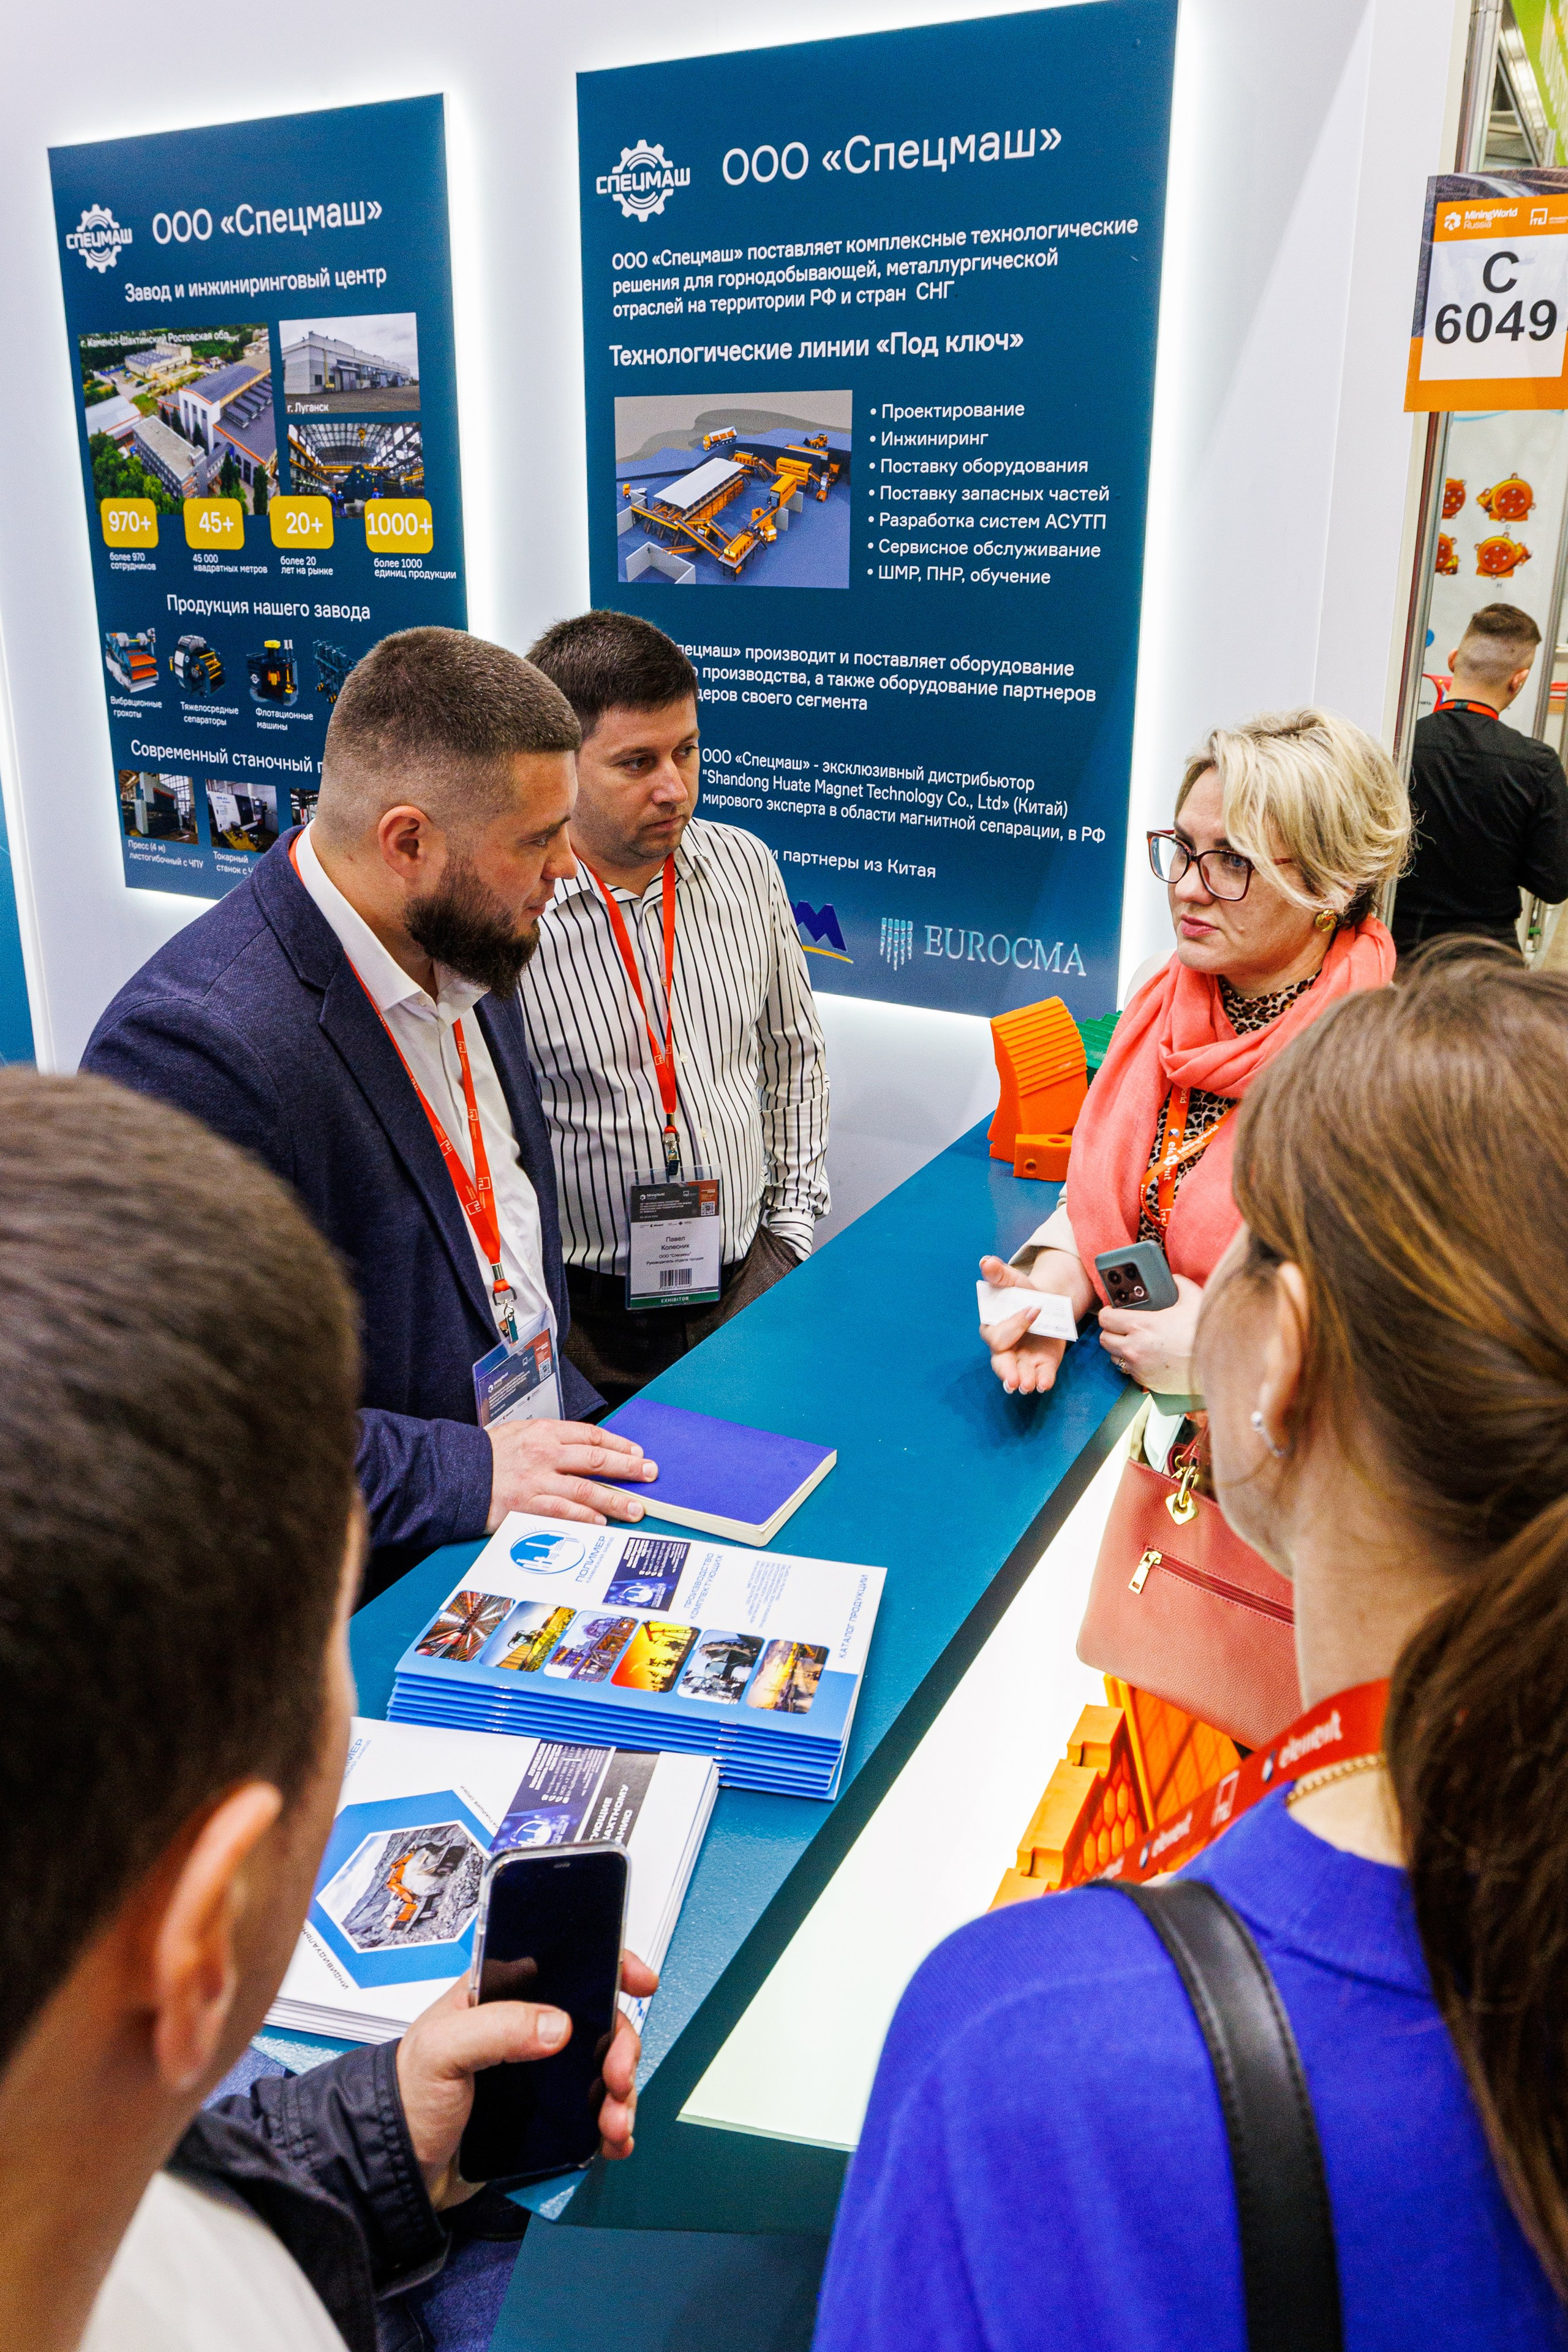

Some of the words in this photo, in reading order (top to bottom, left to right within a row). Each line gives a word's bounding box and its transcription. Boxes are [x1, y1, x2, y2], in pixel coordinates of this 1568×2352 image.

[722, 141, 809, 186] ООО
[822, 128, 1062, 174] «Спецмаш»
[596, 167, 690, 194] СПЕЦМАШ
[153, 208, 213, 244] ООО
[221, 201, 382, 236] «Спецмаш»
[1463, 219, 1493, 230] Russia
[1464, 207, 1518, 221] MiningWorld
[66, 228, 133, 249] СПЕЦМАШ
[612, 251, 648, 270] ООО
[652, 248, 743, 266] «Спецмаш»
[747, 239, 842, 260] поставляет
[846, 230, 967, 253] комплексные
[971, 218, 1139, 244] технологические
[612, 275, 679, 297] решения
[683, 274, 714, 292] для
[718, 258, 881, 290] горнодобывающей,
[886, 247, 1059, 276] металлургической
[124, 283, 172, 303] Завод
[175, 284, 184, 298] и
[189, 267, 330, 298] инжиниринговый
[335, 267, 387, 289] центр
[612, 297, 684, 320] отраслей
[688, 298, 706, 313] на
[710, 292, 805, 314] территории
[810, 287, 836, 306] РФ
[841, 290, 851, 304] и
[856, 287, 906, 307] стран
[916, 280, 955, 301] СНГ
[1434, 299, 1558, 344] 6049
[167, 333, 213, 343] Ростовская
[609, 341, 793, 367] Технологические
[798, 339, 869, 359] линии
[876, 331, 939, 358] «Под
[946, 332, 1024, 353] ключ»
[287, 404, 293, 413] г.
[295, 402, 330, 415] Луганск
[881, 404, 1025, 422] Проектирование
[881, 431, 989, 449] Инжиниринг
[880, 458, 958, 476] Поставку
[962, 458, 1088, 476] оборудования
[880, 485, 957, 503] Поставку
[961, 488, 1044, 502] запасных
[1048, 485, 1110, 502] частей
[108, 511, 151, 532] 970+
[199, 511, 234, 533] 45+
[285, 512, 323, 534] 20+
[368, 513, 432, 535] 1000+
[880, 512, 974, 530] Разработка
[979, 515, 1040, 529] систем
[1044, 513, 1106, 530] АСУТП
[110, 552, 131, 561] более
[132, 552, 145, 562] 970
[192, 554, 203, 562] 45
[204, 554, 219, 564] 000
[878, 538, 968, 557] Сервисное
[973, 540, 1101, 559] обслуживание
[110, 562, 157, 571] сотрудников
[194, 564, 239, 573] квадратных
[239, 566, 268, 575] метров
[281, 556, 304, 565] более
[306, 557, 316, 565] 20
[374, 558, 399, 568] более
[401, 559, 422, 568] 1000
[308, 568, 333, 576] рынке
[375, 570, 407, 579] единиц
[409, 570, 457, 579] продукции
[878, 565, 921, 582] ШМР,
[927, 566, 965, 583] ПНР,
[970, 567, 1051, 586] обучение
[167, 594, 249, 616] Продукция
[254, 601, 309, 616] нашего
[314, 604, 371, 622] завода
[677, 644, 741, 659] пецмаш»
[745, 646, 836, 665] производит
[840, 652, 850, 664] и
[854, 652, 946, 669] поставляет
[950, 654, 1074, 676] оборудование
[703, 666, 811, 686] производства,
[815, 673, 824, 685] а
[827, 674, 875, 688] также
[879, 674, 998, 696] оборудование
[1003, 684, 1096, 704] партнеров
[110, 696, 162, 708] Вибрационные
[181, 701, 239, 715] Тяжелосредные
[741, 690, 793, 705] своего
[796, 693, 867, 710] сегмента
[114, 709, 142, 718] грохоты
[184, 715, 227, 726] сепараторы
[255, 707, 314, 720] Флотационные
[257, 721, 288, 731] машины
[131, 739, 228, 764] Современный
[232, 752, 312, 773] станочный
[702, 748, 732, 764] ООО
[735, 751, 810, 771] «Спецмаш»
[823, 761, 924, 781] эксклюзивный
[928, 769, 1035, 794] дистрибьютор
[703, 769, 769, 791] "Shandong
[773, 776, 811, 793] Huate
[815, 778, 863, 799] Magnet
[867, 783, 943, 808] Technology
[948, 790, 973, 810] Co.,
[978, 794, 1009, 810] Ltd»
[1014, 796, 1068, 819] (Китай)
[703, 793, 763, 809] мирового
[766, 799, 826, 816] эксперта
[829, 805, 837, 816] в
[840, 804, 895, 823] области
[900, 812, 975, 831] магнитной
[979, 820, 1064, 842] сепарации,
[1068, 828, 1077, 841] в
[1081, 826, 1106, 843] РФ
[128, 840, 149, 851] Пресс
[150, 841, 157, 852] (4
[157, 843, 165, 853] м)
[129, 853, 182, 867] листогибочный
[189, 859, 204, 869] ЧПУ
[213, 851, 249, 864] Токарный
[783, 850, 859, 871] партнеры
[864, 860, 883, 872] из
[888, 859, 937, 878] Китая
[216, 865, 241, 874] станок
[924, 925, 1087, 976] EUROCMA
[1177, 1124, 1219, 1155] MiningWorld
[575, 1535, 606, 1582] ПОЛИМЕР
[684, 1552, 714, 1609] ПРОИЗВОДСТВО
[689, 1554, 724, 1620] КОМПЛЕКТУЮЩИХ
[839, 1623, 854, 1659] КАТАЛОГ
[849, 1574, 869, 1622] ПРОДУКЦИИ
[302, 1928, 349, 1990] ИНДИВИДУАЛЬН
